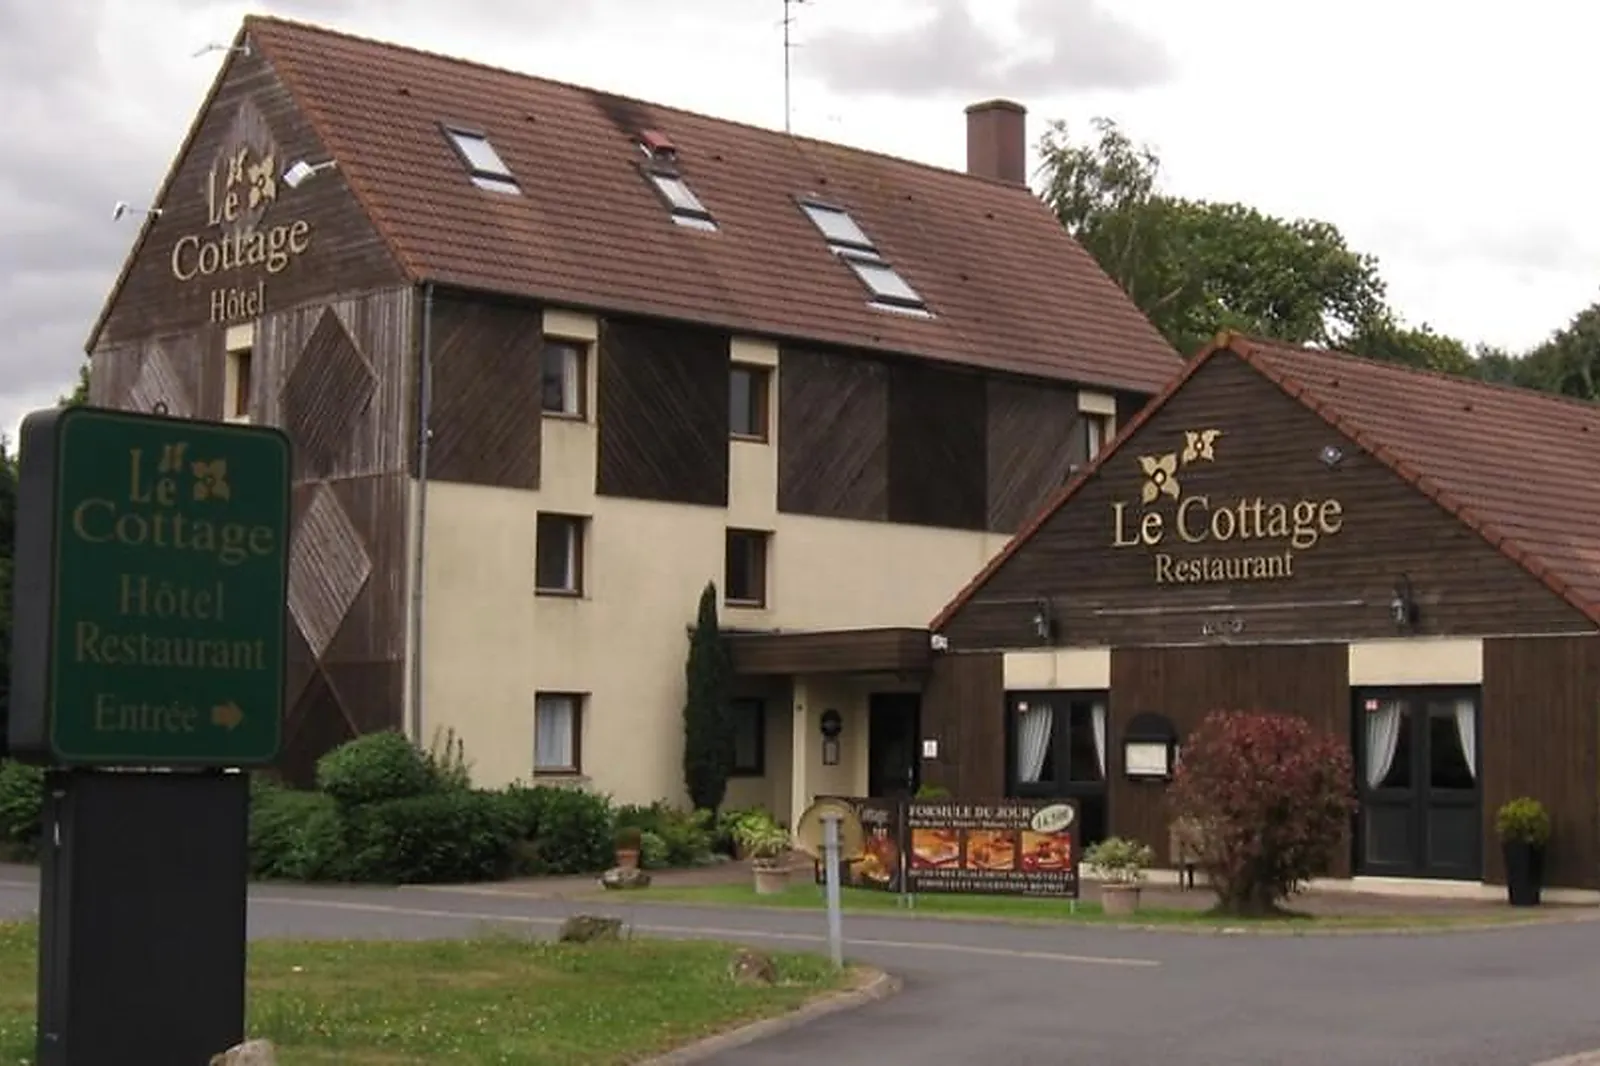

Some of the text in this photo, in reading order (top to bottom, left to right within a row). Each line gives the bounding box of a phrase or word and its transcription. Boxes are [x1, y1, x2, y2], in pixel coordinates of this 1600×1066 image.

[208, 167, 239, 226] Le
[172, 220, 309, 280] Cottage
[210, 280, 265, 322] Hôtel
[129, 448, 177, 506] Le
[73, 498, 274, 566] Cottage
[1111, 496, 1342, 549] Le Cottage
[1155, 551, 1293, 583] Restaurant
[119, 573, 225, 622] Hôtel
[75, 620, 267, 671] Restaurant
[94, 692, 199, 732] Entrée
